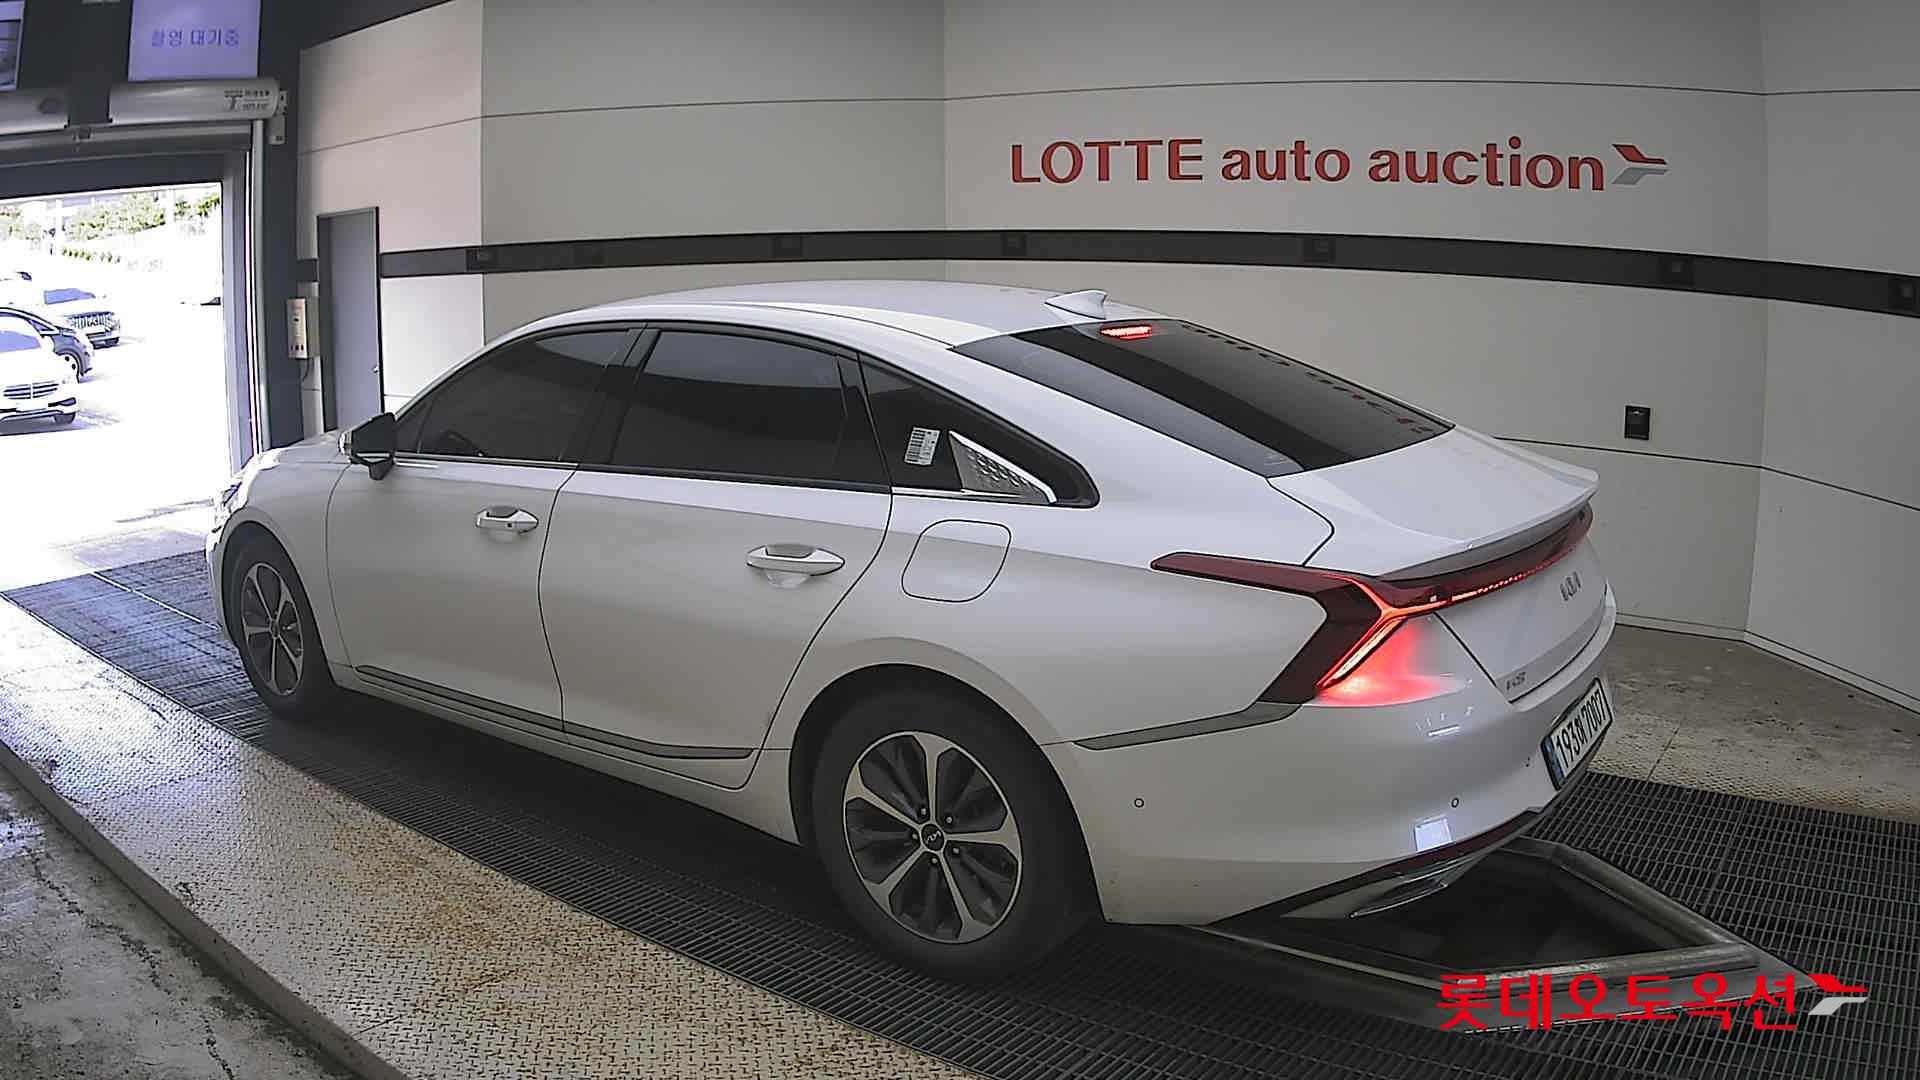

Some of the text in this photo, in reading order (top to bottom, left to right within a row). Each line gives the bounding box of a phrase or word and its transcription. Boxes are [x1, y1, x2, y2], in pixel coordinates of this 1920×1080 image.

[1011, 136, 1605, 191] LOTTE auto auction
